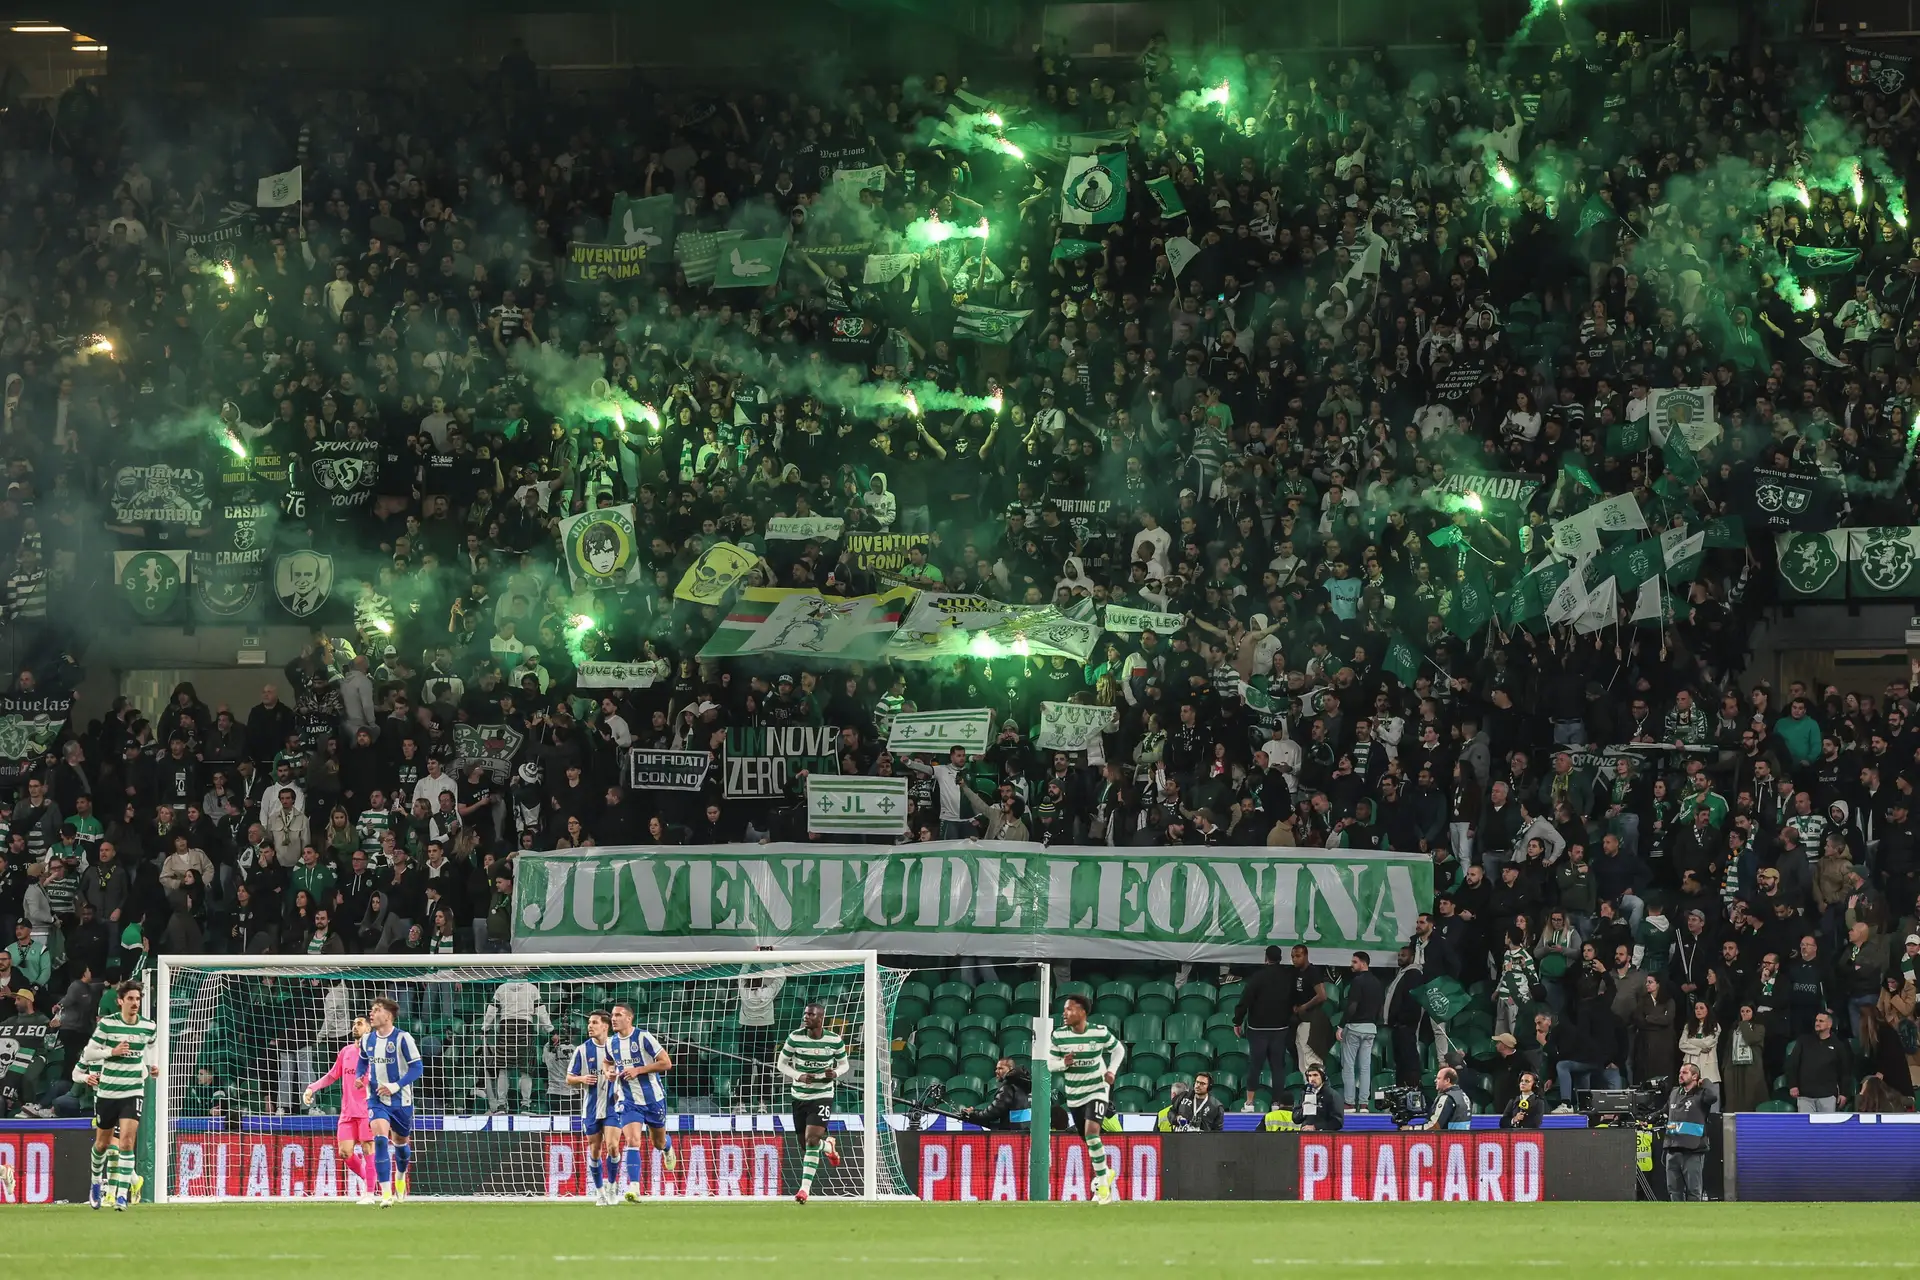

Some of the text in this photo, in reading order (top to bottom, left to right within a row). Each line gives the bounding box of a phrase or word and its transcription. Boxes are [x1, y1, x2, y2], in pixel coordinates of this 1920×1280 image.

[176, 224, 243, 245] Sporting
[571, 245, 647, 263] JUVENTUDE
[1660, 394, 1700, 407] SPORTING
[134, 467, 192, 479] TURMA
[1753, 466, 1787, 478] Sporting
[286, 493, 306, 518] 76
[331, 490, 370, 507] YOUTH
[224, 505, 268, 518] CASAL
[1098, 500, 1111, 512] CP
[571, 513, 632, 538] JUVE LEO
[216, 548, 266, 566] CAMBR
[935, 597, 987, 608] JUV
[1108, 613, 1181, 628] JUVE LEO
[579, 667, 655, 676] JUVE LEO
[2, 697, 71, 712] divelas
[924, 724, 948, 738] JL
[1046, 725, 1087, 747] LE
[637, 754, 705, 767] DIFFIDATI
[1553, 752, 1616, 768] ORTING
[638, 771, 673, 783] CON
[727, 757, 787, 794] ZERO
[841, 796, 865, 813] JL
[522, 856, 1420, 943] JUVENTUDE LEONINA
[15, 1025, 47, 1037] LEO
[369, 1056, 395, 1065] Betano
[1072, 1058, 1095, 1067] etano
[344, 1067, 356, 1076] Bet
[3, 1086, 18, 1097] CA
[818, 1105, 830, 1118] 26
[1094, 1101, 1105, 1117] 10
[923, 1143, 1158, 1201] PLAARD
[1303, 1142, 1539, 1201] PLACARD
